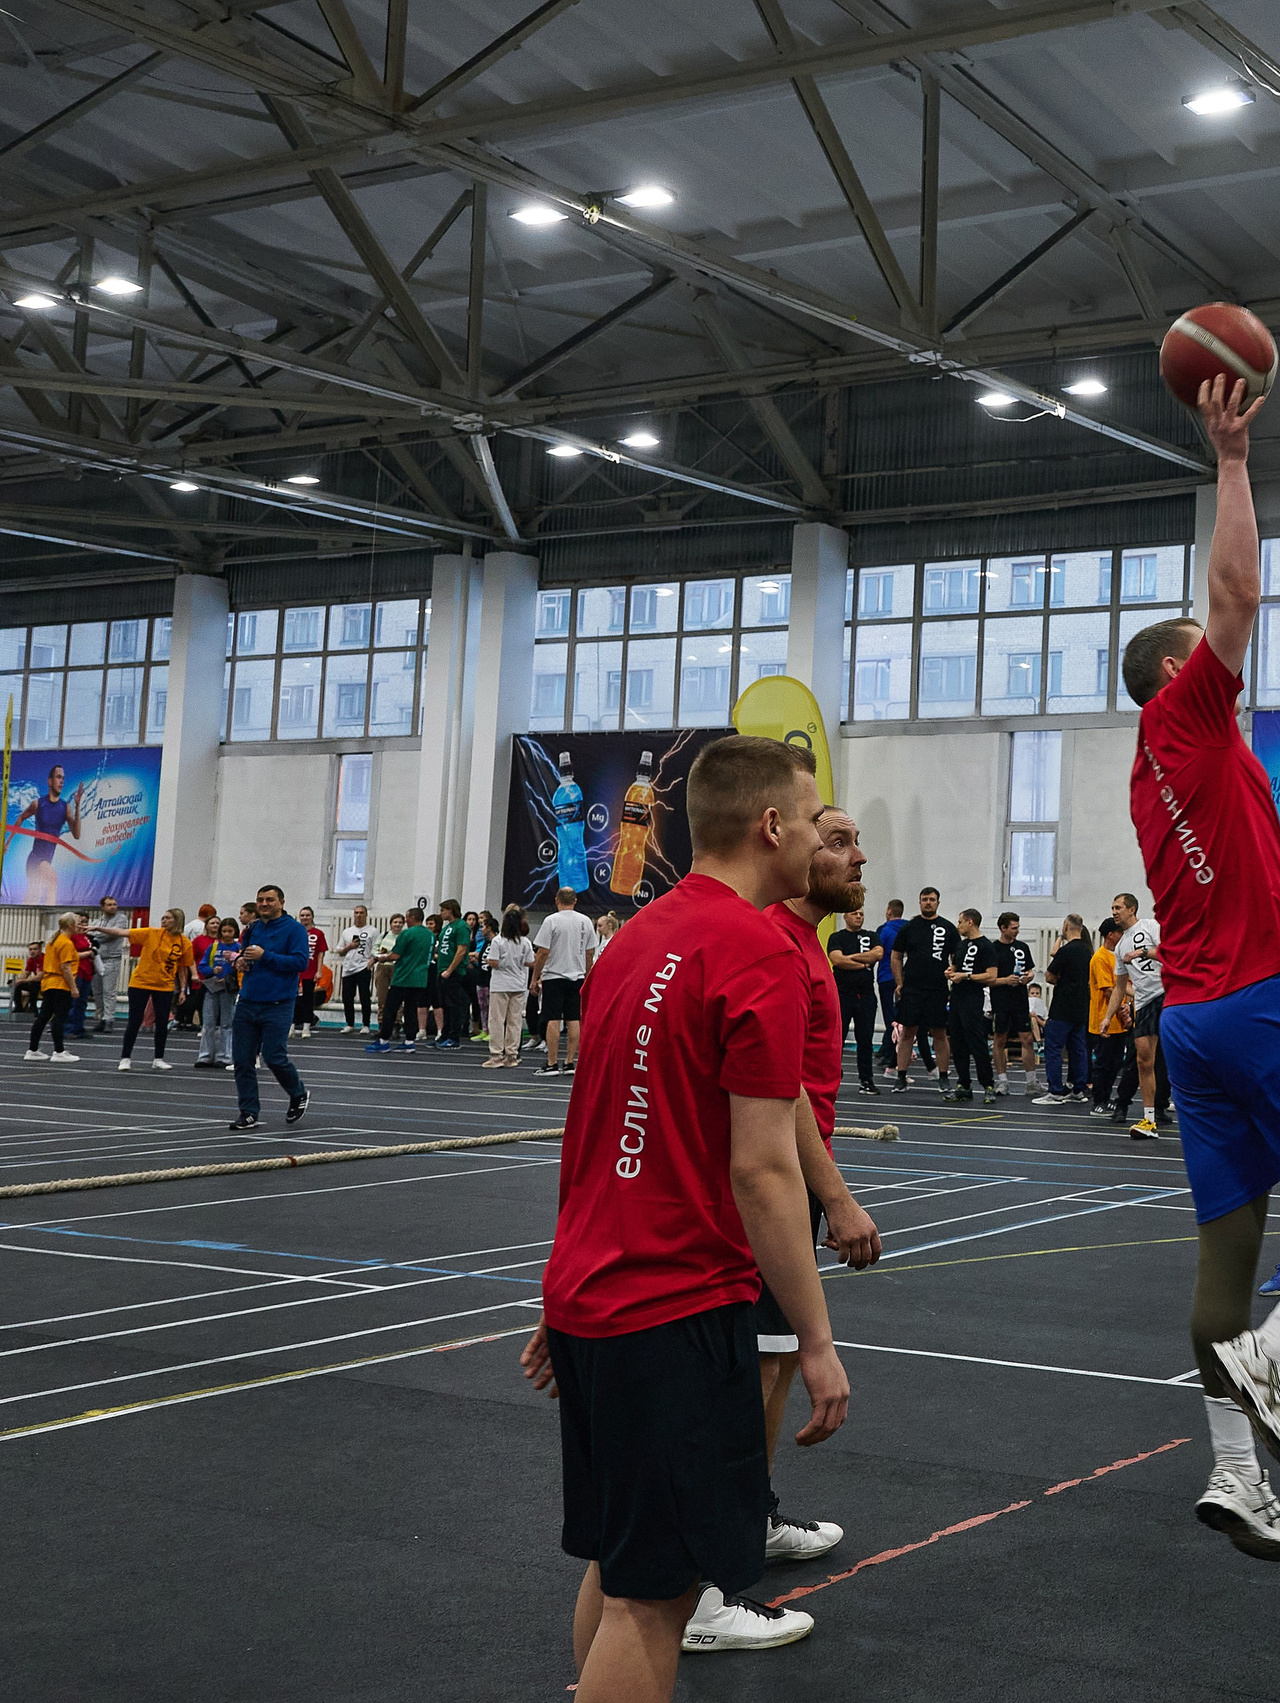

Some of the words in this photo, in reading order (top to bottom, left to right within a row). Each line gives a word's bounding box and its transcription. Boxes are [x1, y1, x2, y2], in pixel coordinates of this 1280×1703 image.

[94, 792, 143, 811] Алтайский
[1160, 785, 1182, 820] не
[102, 815, 151, 835] вдохновляет
[591, 813, 605, 823] Mg
[542, 848, 553, 856] Ca
[1175, 820, 1214, 884] если
[637, 890, 649, 898] Na
[962, 945, 978, 975] КТО
[615, 1085, 649, 1179] если
[633, 1024, 652, 1072] не
[644, 952, 683, 1013] мы
[687, 1634, 717, 1645] 30
